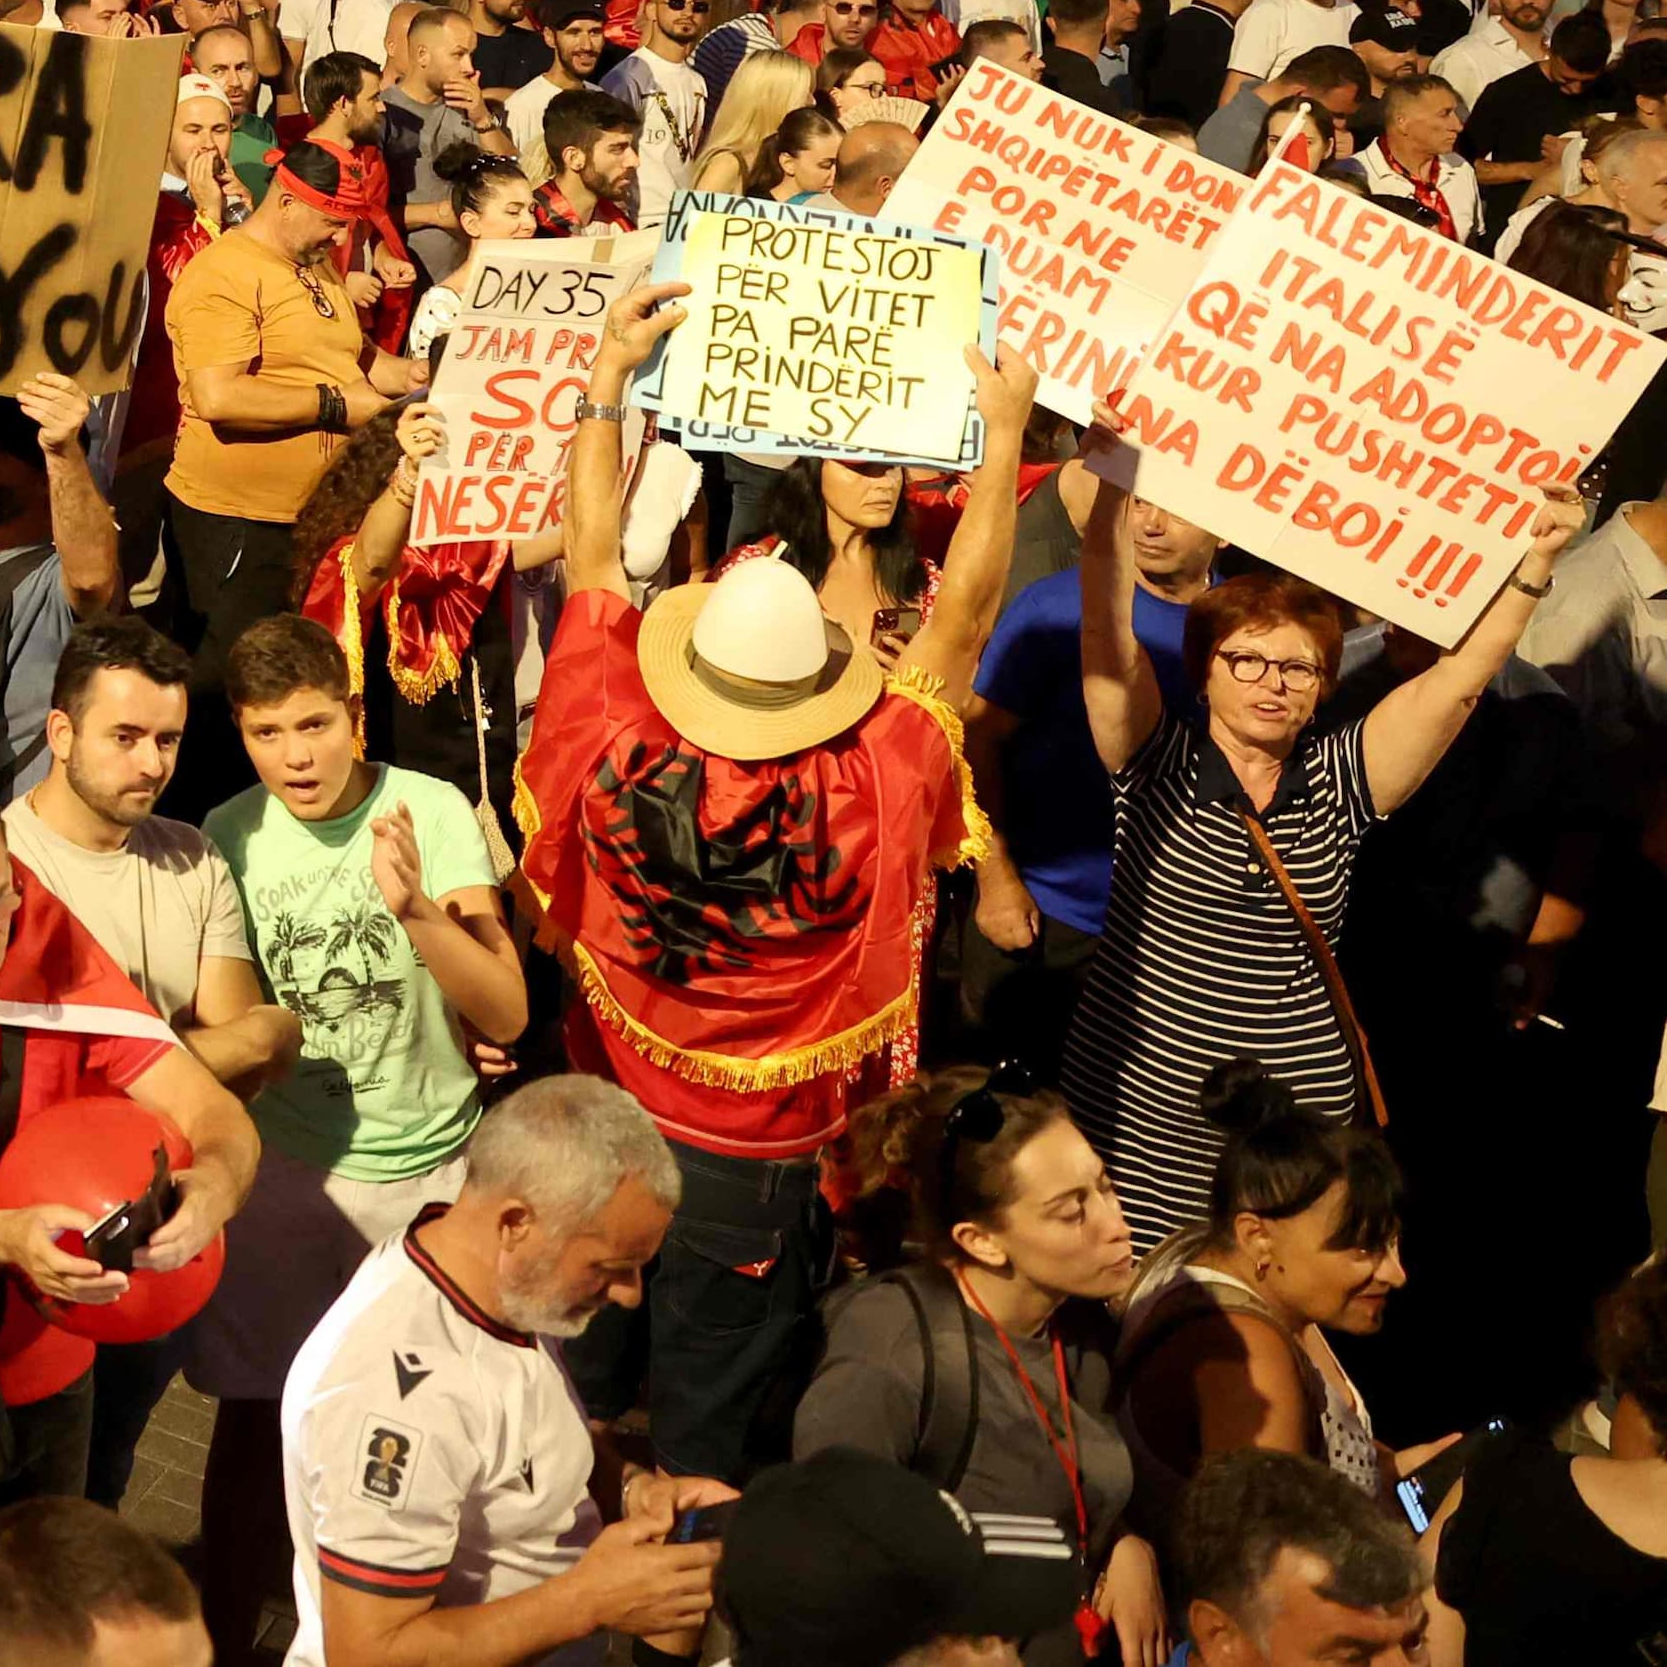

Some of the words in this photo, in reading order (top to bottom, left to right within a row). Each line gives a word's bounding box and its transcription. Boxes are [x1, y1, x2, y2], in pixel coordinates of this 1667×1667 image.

[969, 65, 1033, 116] JU
[1035, 100, 1135, 164] NUK
[722, 217, 941, 281] PROTESTOJ
[956, 166, 1057, 236] POR
[1062, 219, 1138, 273] NE
[472, 266, 549, 314] DAY
[543, 270, 614, 316] 35
[717, 263, 789, 304] PËR
[933, 201, 967, 234] E
[982, 223, 1112, 316] DUAM
[1249, 165, 1643, 384] FALEMINDERIT
[455, 325, 536, 364] JAM
[711, 304, 759, 342] PA
[790, 316, 894, 367] PARË
[1187, 281, 1270, 345] QË
[1269, 321, 1346, 393] NA
[1259, 248, 1482, 386] ITALISË
[698, 382, 770, 428] ME
[808, 398, 872, 442] SY
[1127, 394, 1198, 467] NA
[1152, 332, 1263, 414] KUR
[1278, 393, 1537, 539] PUSHTETI
[464, 431, 535, 472] PËR
